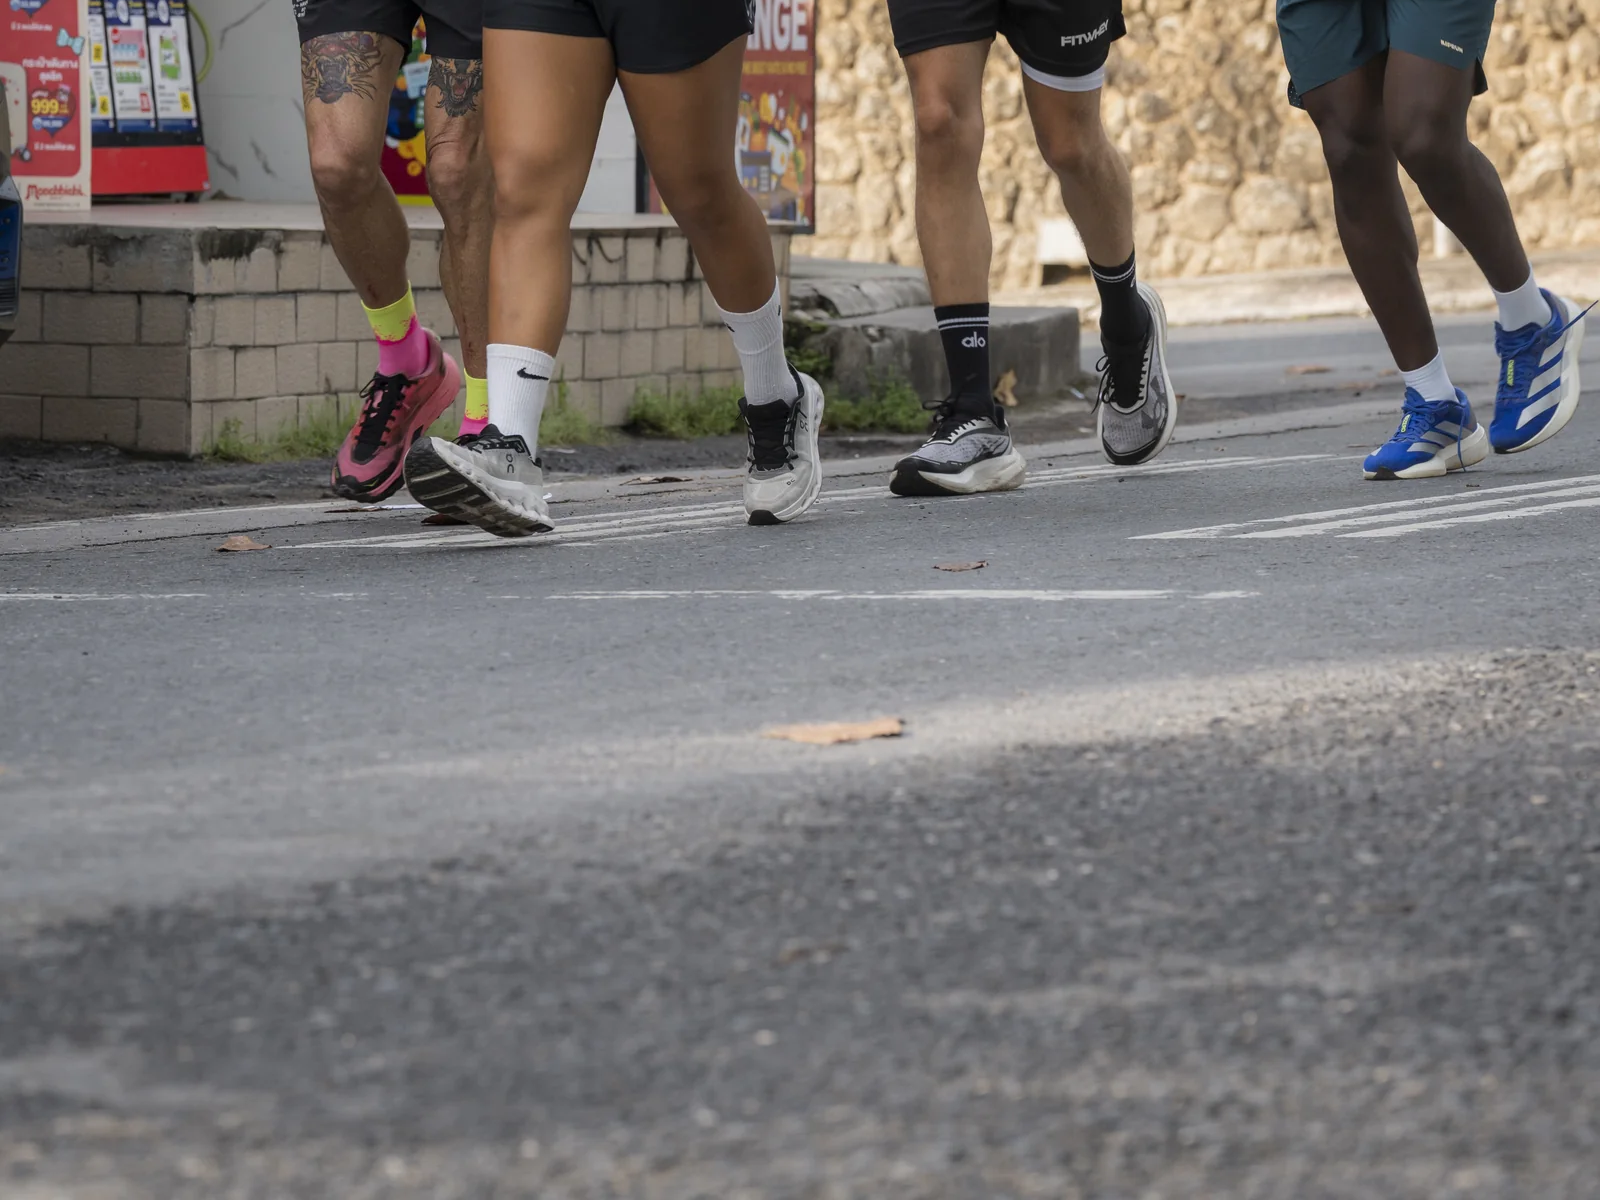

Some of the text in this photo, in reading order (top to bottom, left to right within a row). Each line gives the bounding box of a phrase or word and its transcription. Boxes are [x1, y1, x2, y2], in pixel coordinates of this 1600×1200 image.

[1060, 18, 1109, 47] FITWHEY
[31, 98, 59, 115] 999
[961, 331, 986, 348] alo
